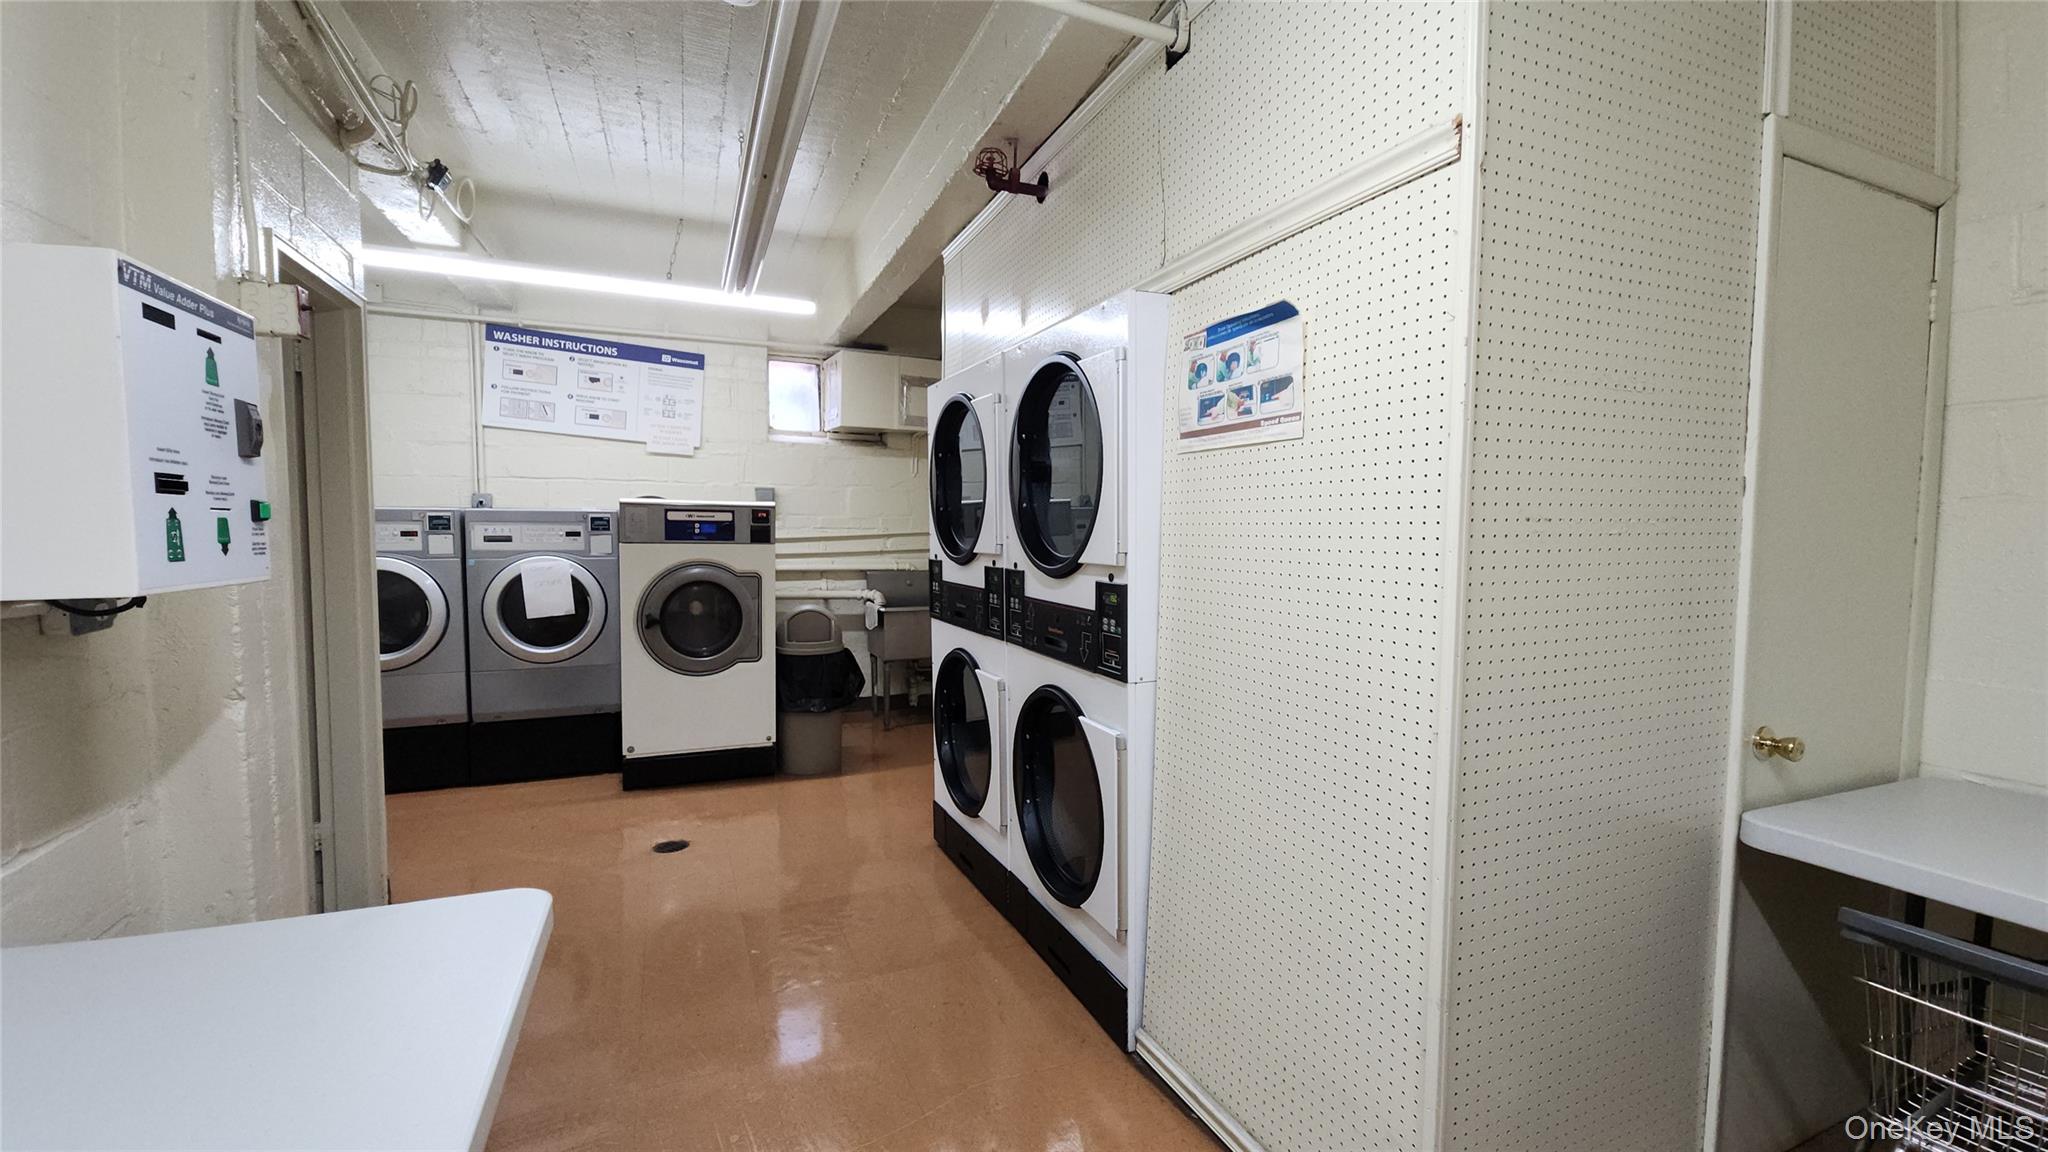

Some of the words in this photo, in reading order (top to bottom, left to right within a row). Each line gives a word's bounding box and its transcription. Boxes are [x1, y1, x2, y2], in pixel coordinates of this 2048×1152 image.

[121, 262, 152, 292] VTM
[153, 283, 175, 301] Value
[176, 294, 198, 310] Adder
[199, 303, 215, 318] Plus
[493, 330, 540, 346] WASHER
[542, 334, 618, 356] INSTRUCTIONS
